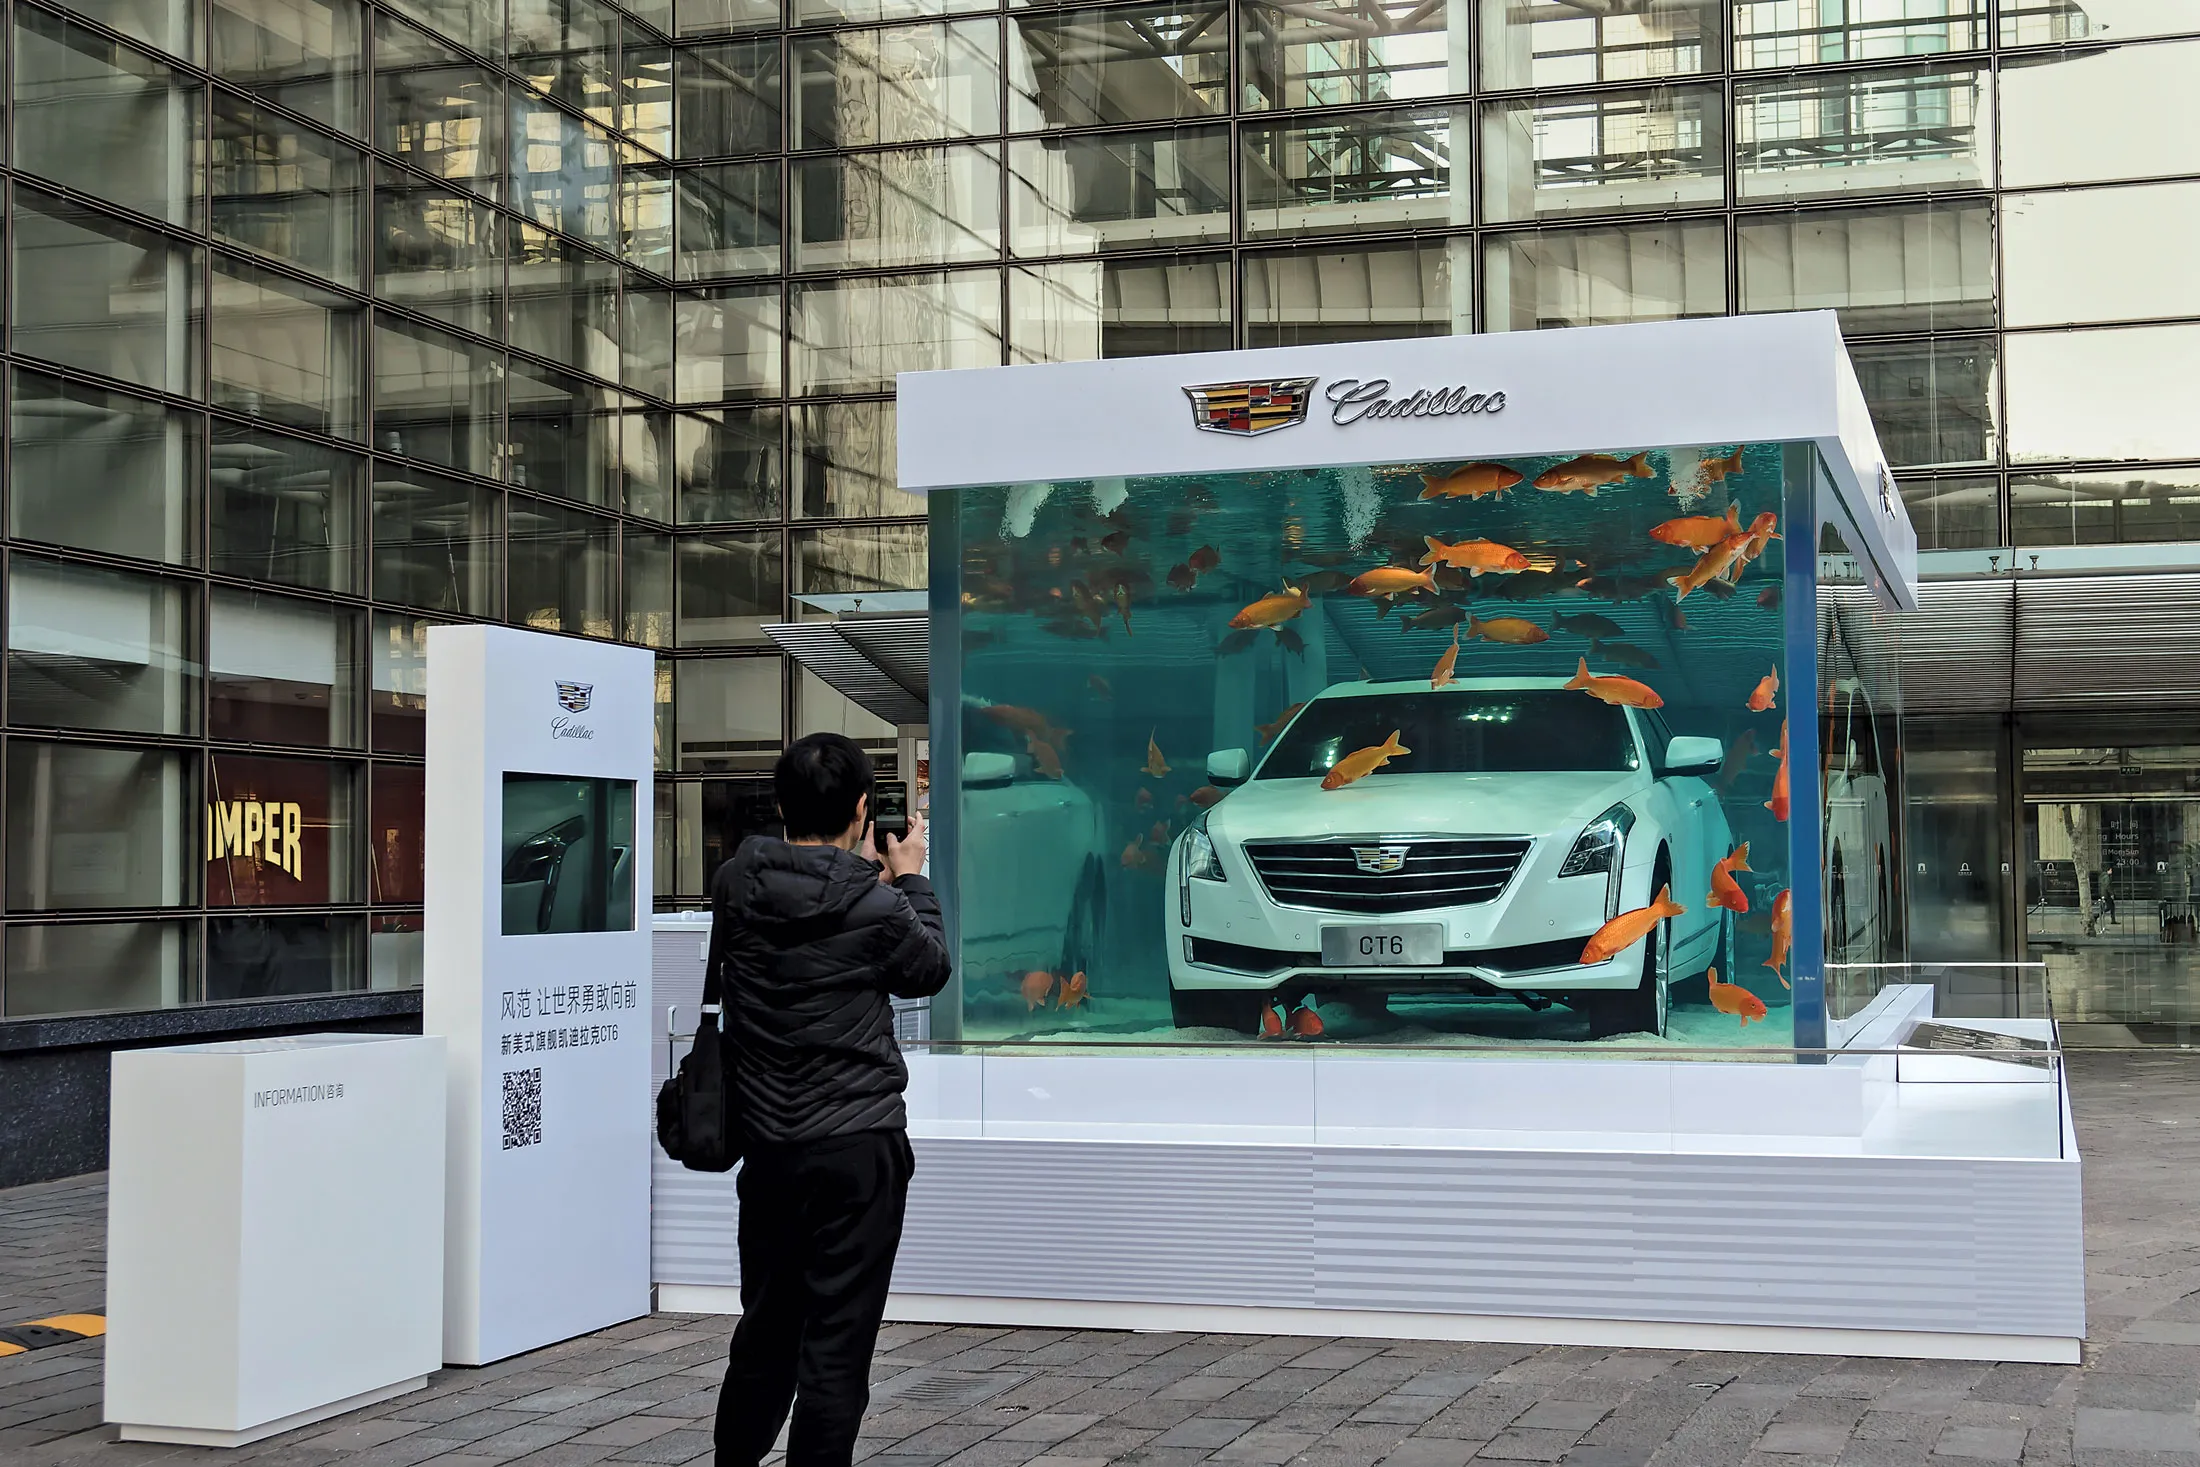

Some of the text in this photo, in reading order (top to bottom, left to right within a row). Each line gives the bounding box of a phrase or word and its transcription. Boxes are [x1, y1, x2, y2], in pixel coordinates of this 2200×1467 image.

[1325, 376, 1507, 426] Cadillac
[551, 716, 594, 740] Cadillac
[207, 800, 302, 882] MPER
[1360, 935, 1403, 955] CT6
[501, 980, 637, 1020] 风范 让世界勇敢向前
